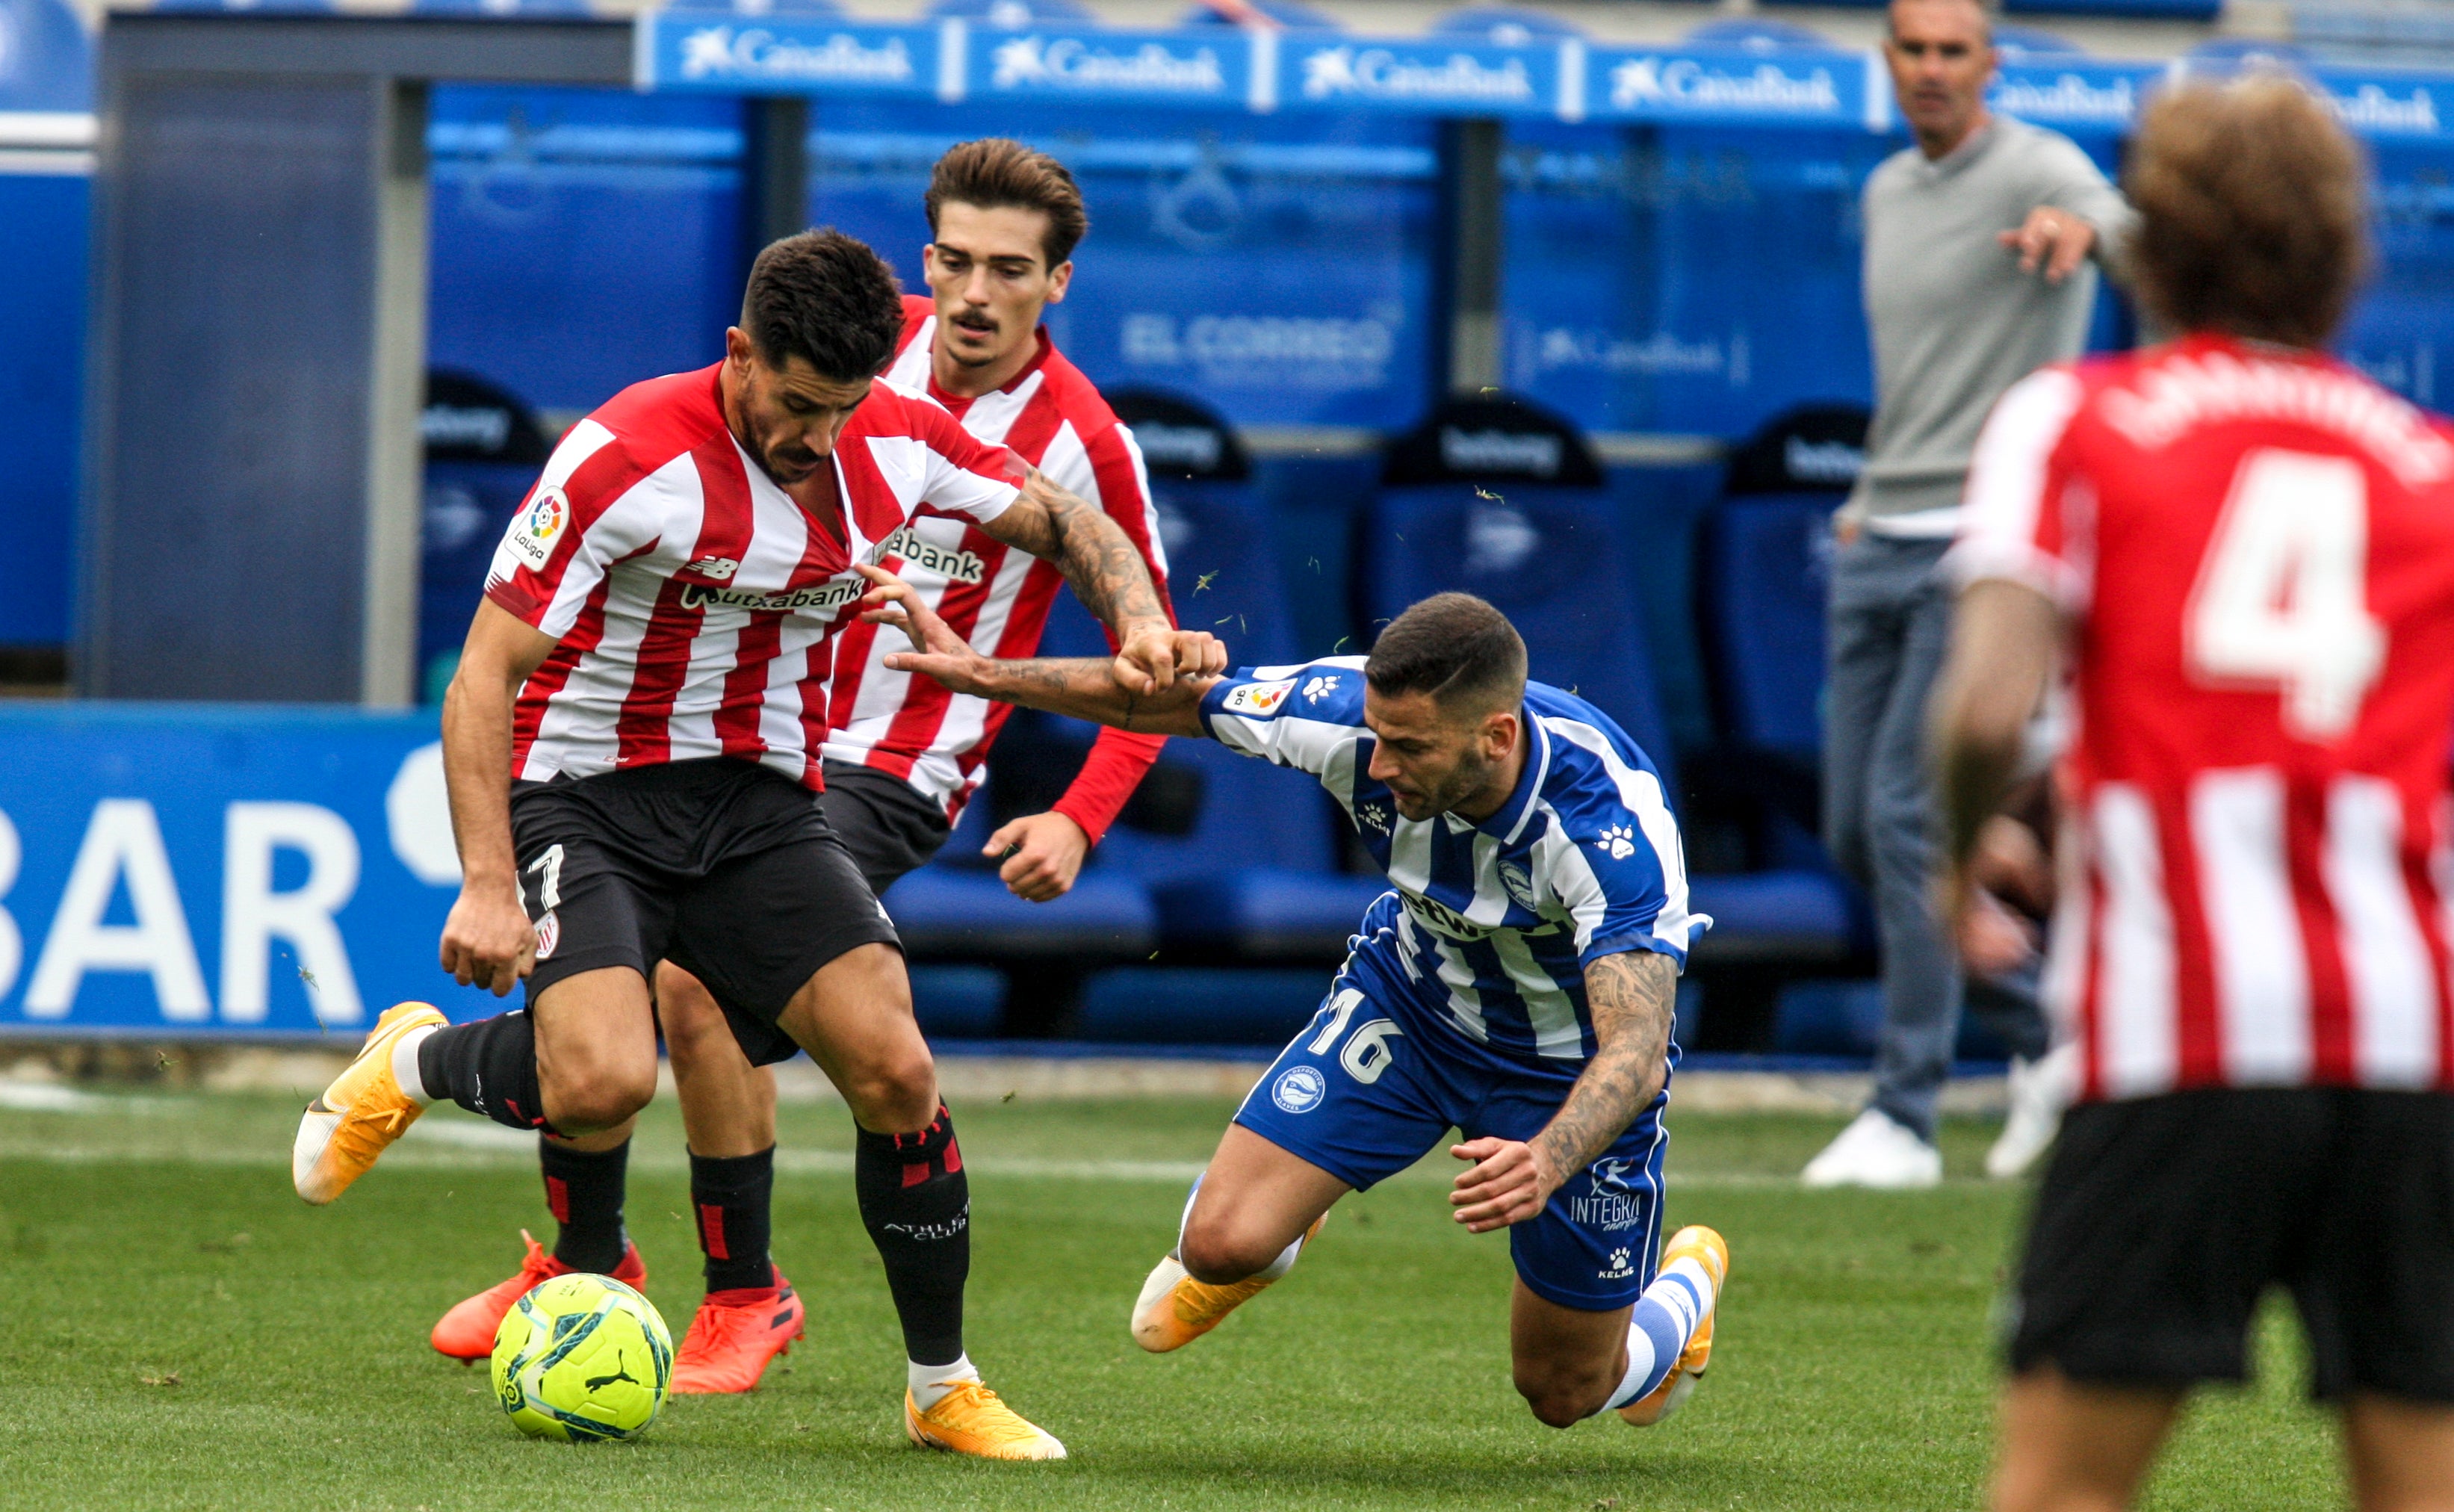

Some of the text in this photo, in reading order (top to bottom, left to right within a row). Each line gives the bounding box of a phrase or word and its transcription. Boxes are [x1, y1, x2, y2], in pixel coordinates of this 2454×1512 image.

[514, 531, 545, 560] LaLiga
[890, 532, 980, 580] abank
[2183, 446, 2388, 743] 4
[515, 844, 564, 918] 7
[1308, 988, 1404, 1084] 16
[1571, 1194, 1641, 1224] INTEGRA
[1599, 1266, 1634, 1279] KELME
